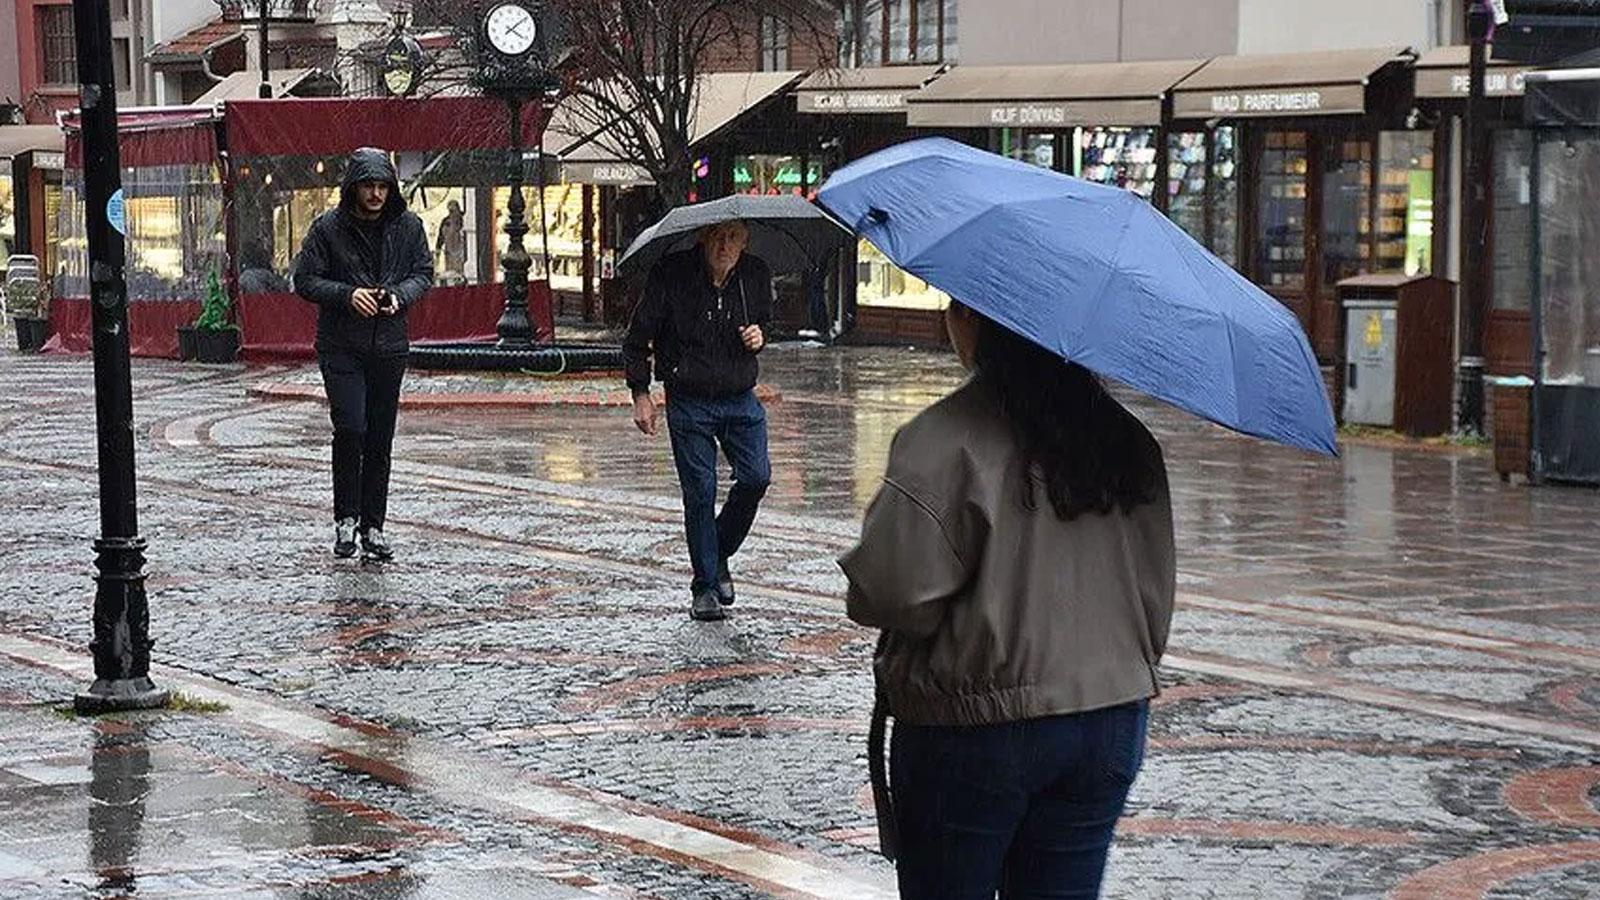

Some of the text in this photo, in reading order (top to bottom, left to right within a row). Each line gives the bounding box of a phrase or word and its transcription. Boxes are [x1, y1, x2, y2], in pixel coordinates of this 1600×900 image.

[1451, 75, 1507, 91] PEUM
[1212, 92, 1319, 111] MAD PARFUMEUR
